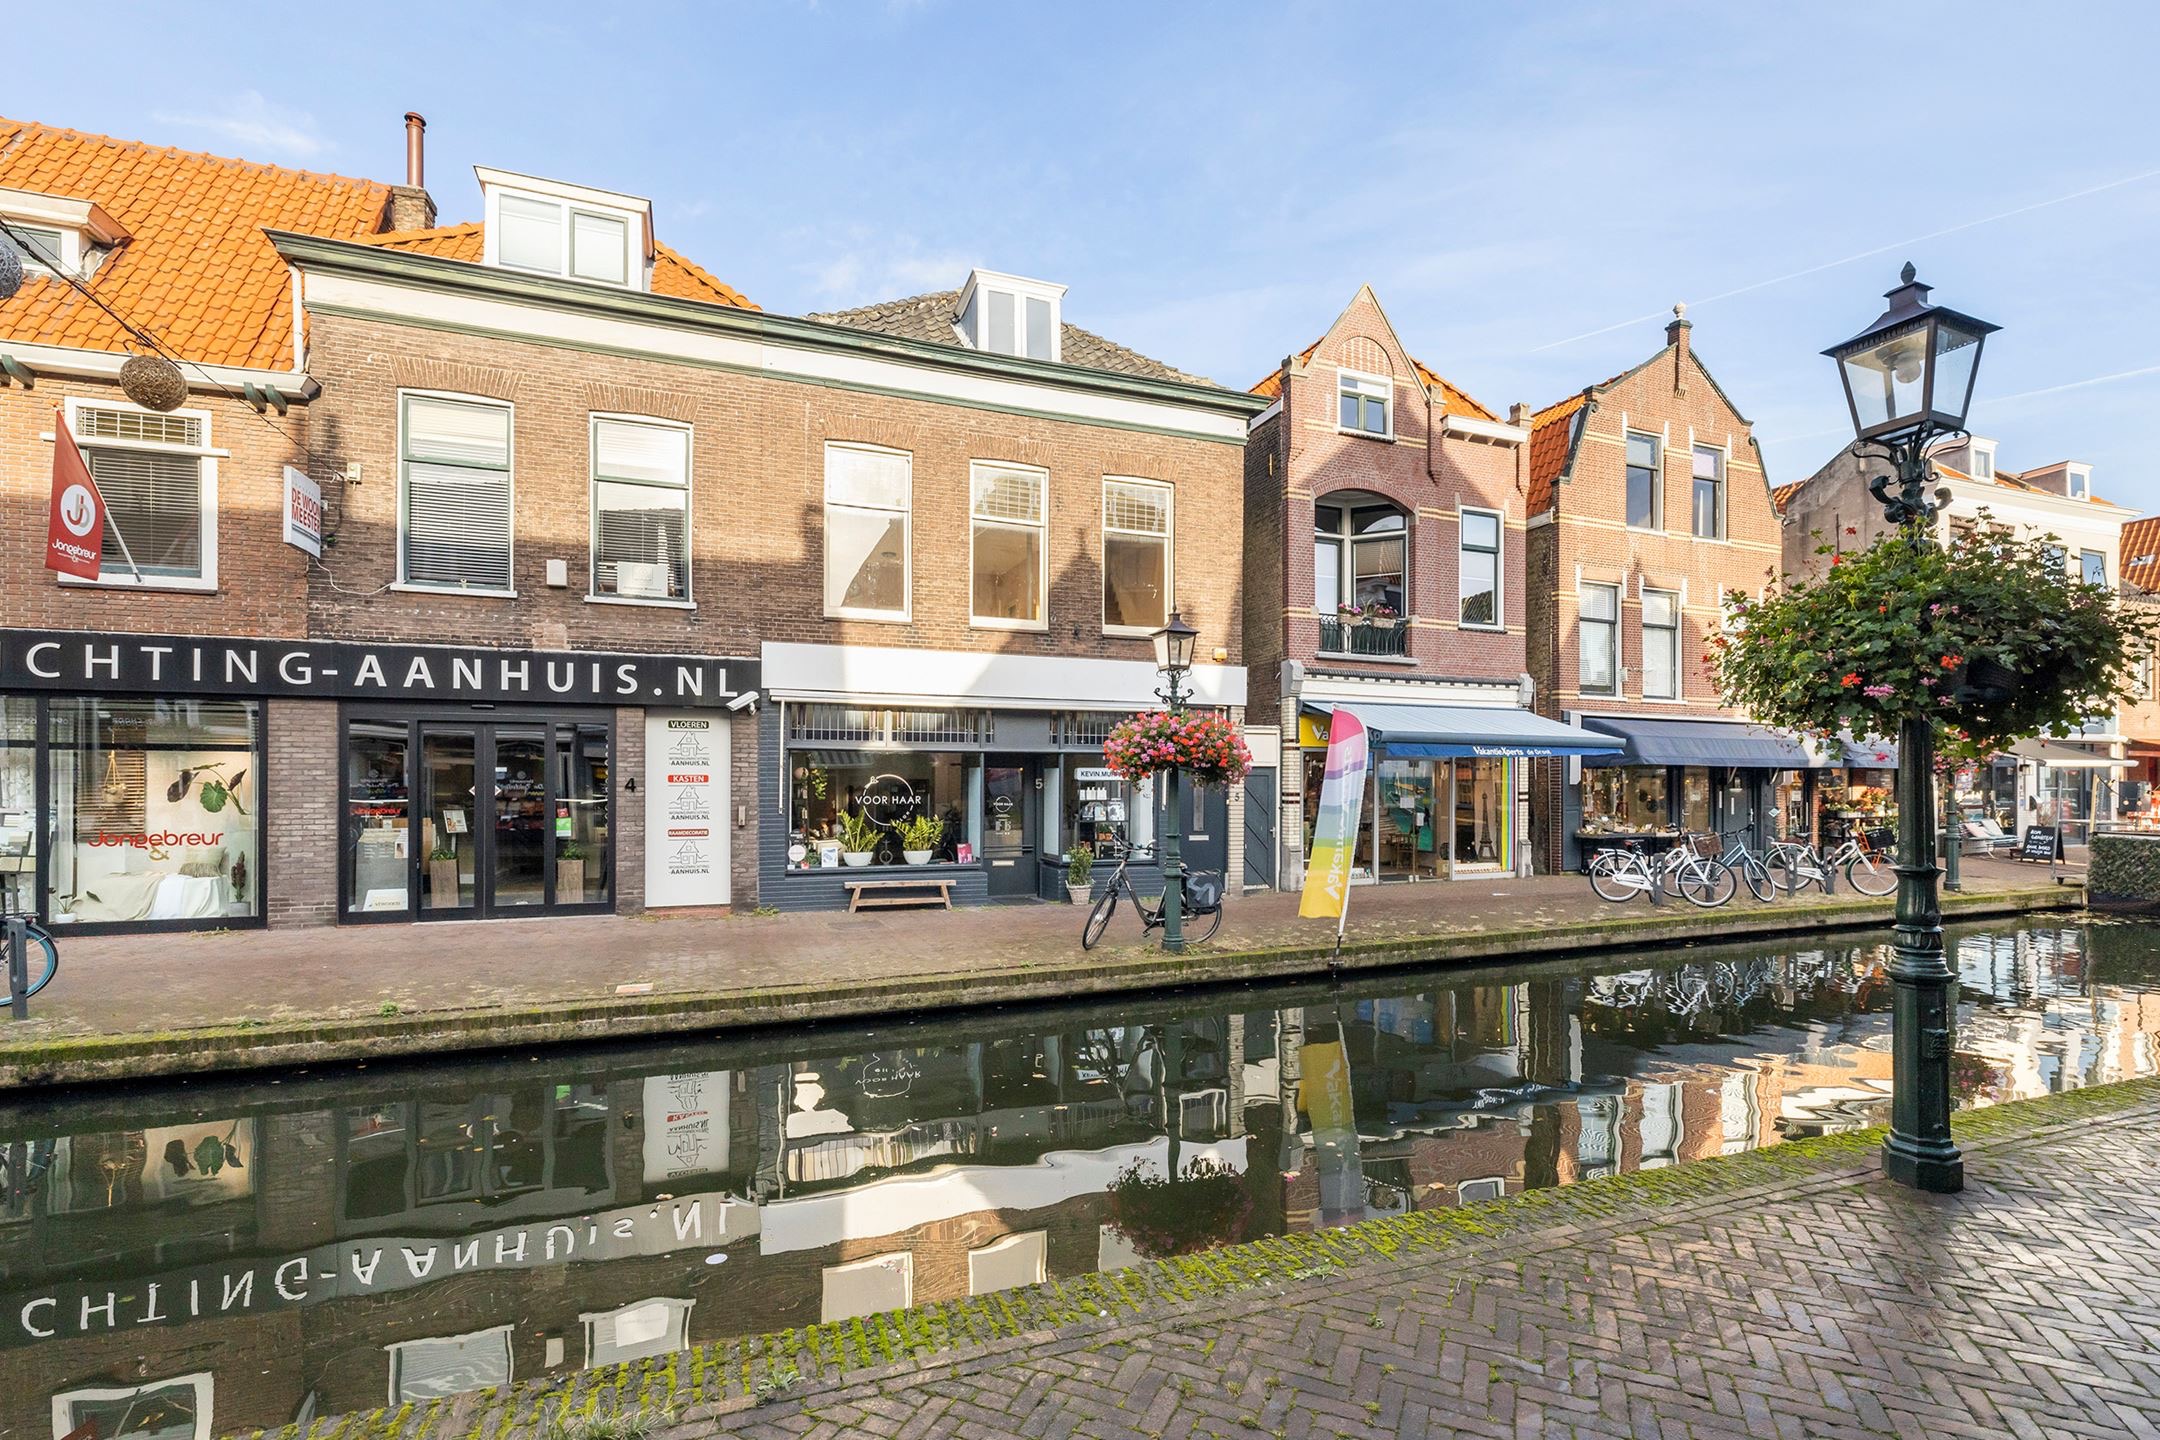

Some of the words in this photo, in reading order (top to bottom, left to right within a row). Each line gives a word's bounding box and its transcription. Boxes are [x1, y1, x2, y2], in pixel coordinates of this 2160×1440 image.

[291, 487, 301, 506] DE
[291, 503, 320, 532] MEESTER
[51, 539, 97, 560] Jongebreur
[0, 641, 738, 698] CHTING-AANHUIS.NL
[1312, 725, 1329, 741] Va
[1472, 745, 1524, 756] VakantieXperts
[624, 778, 637, 793] 4
[672, 775, 705, 783] KASTEN
[1035, 778, 1043, 790] 5
[855, 796, 888, 805] VOOR
[892, 796, 922, 805] HAAR
[87, 830, 224, 850] Jongebreur
